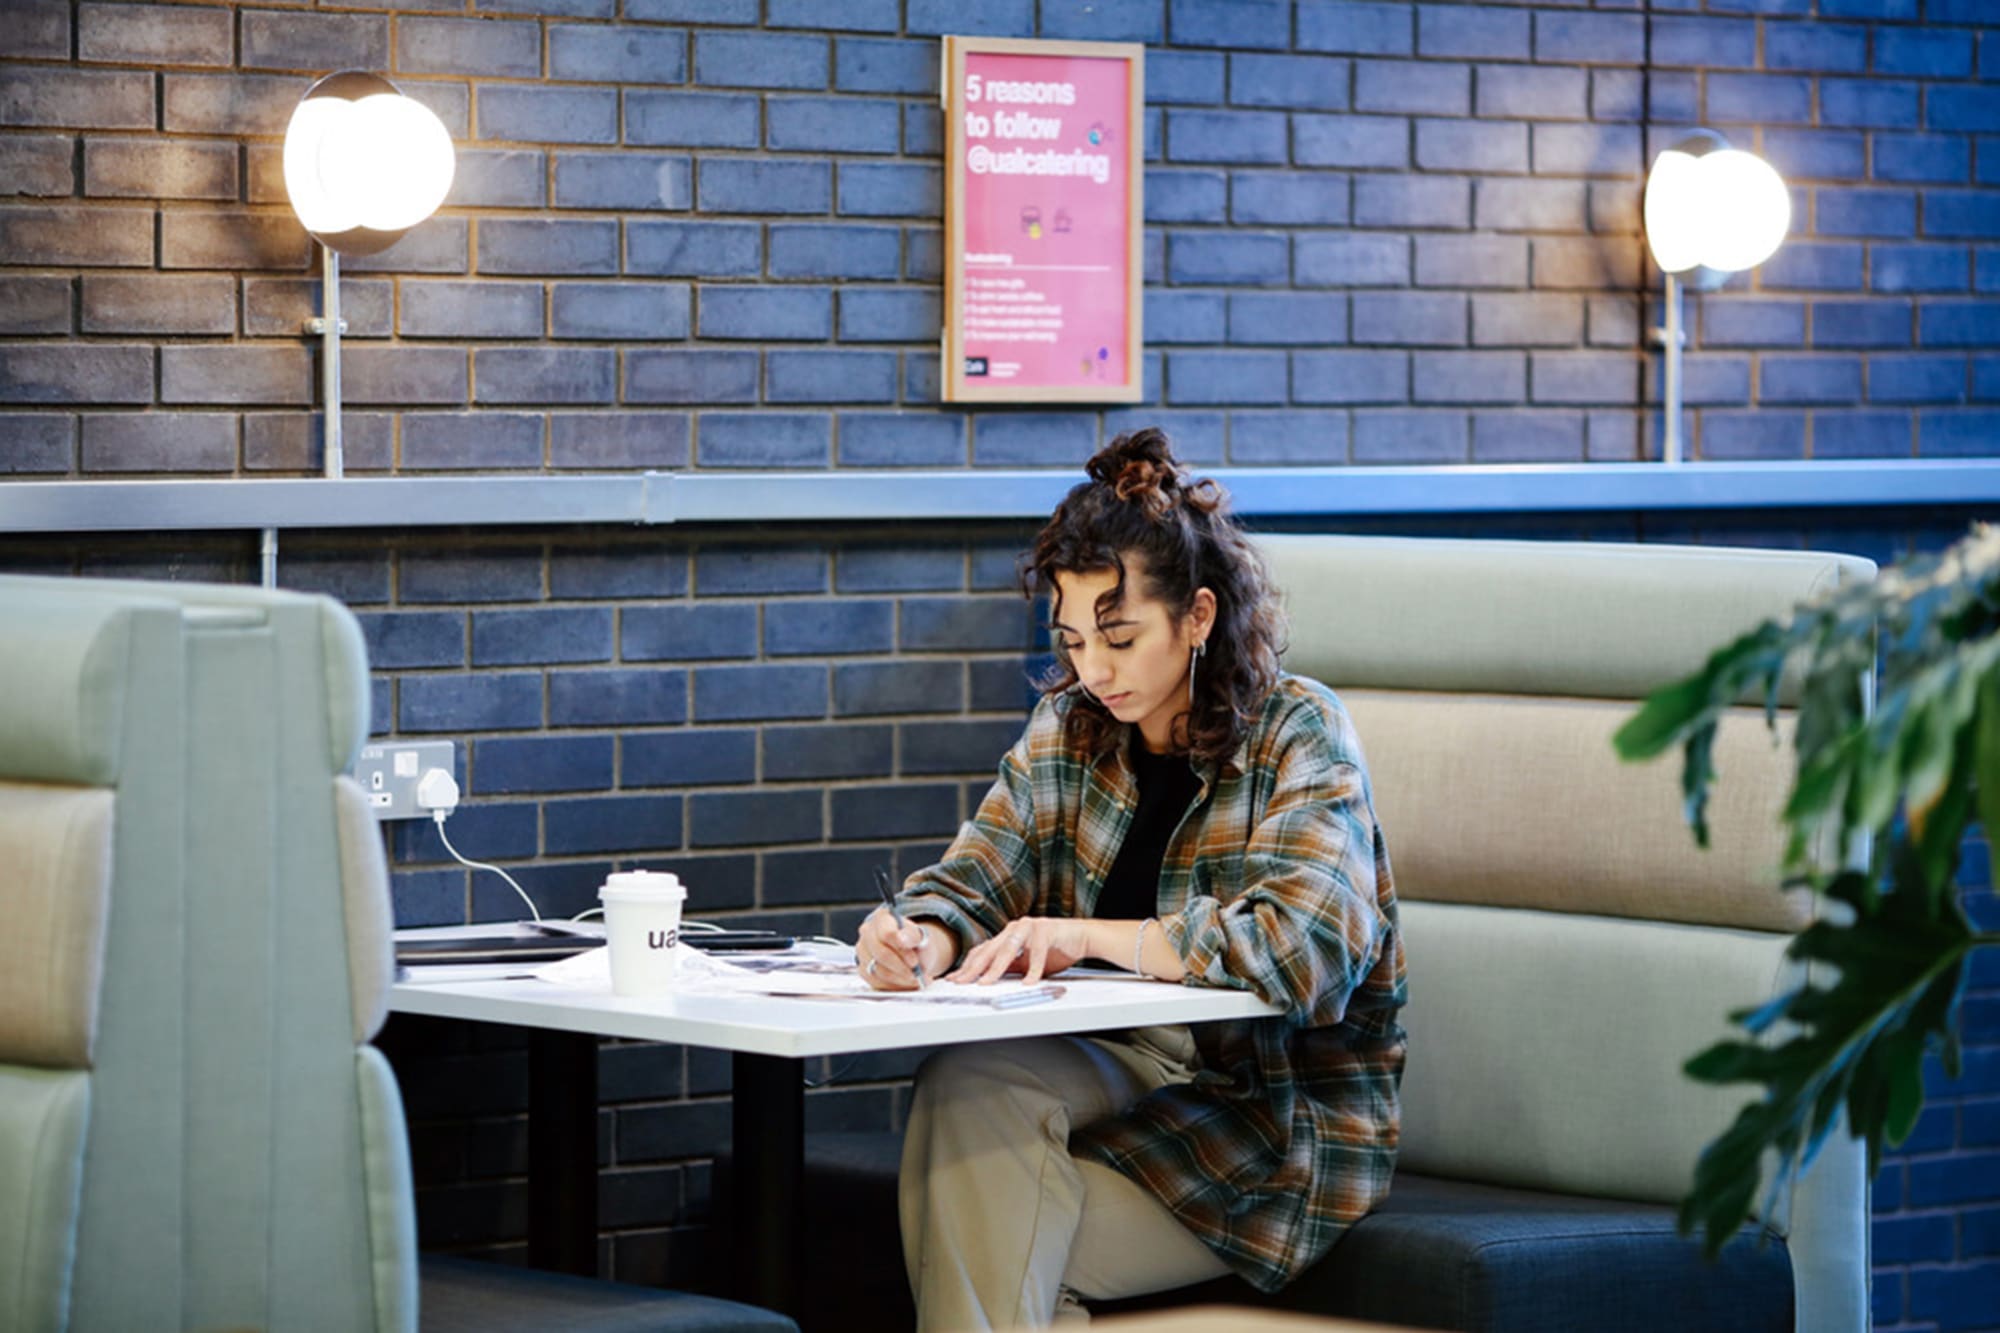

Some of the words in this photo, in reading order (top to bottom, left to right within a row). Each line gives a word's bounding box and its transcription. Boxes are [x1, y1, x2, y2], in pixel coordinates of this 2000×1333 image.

[966, 75, 981, 102] 5
[985, 81, 1076, 105] reasons
[966, 112, 990, 138] to
[993, 111, 1062, 139] follow
[967, 145, 1110, 183] @ualcatering
